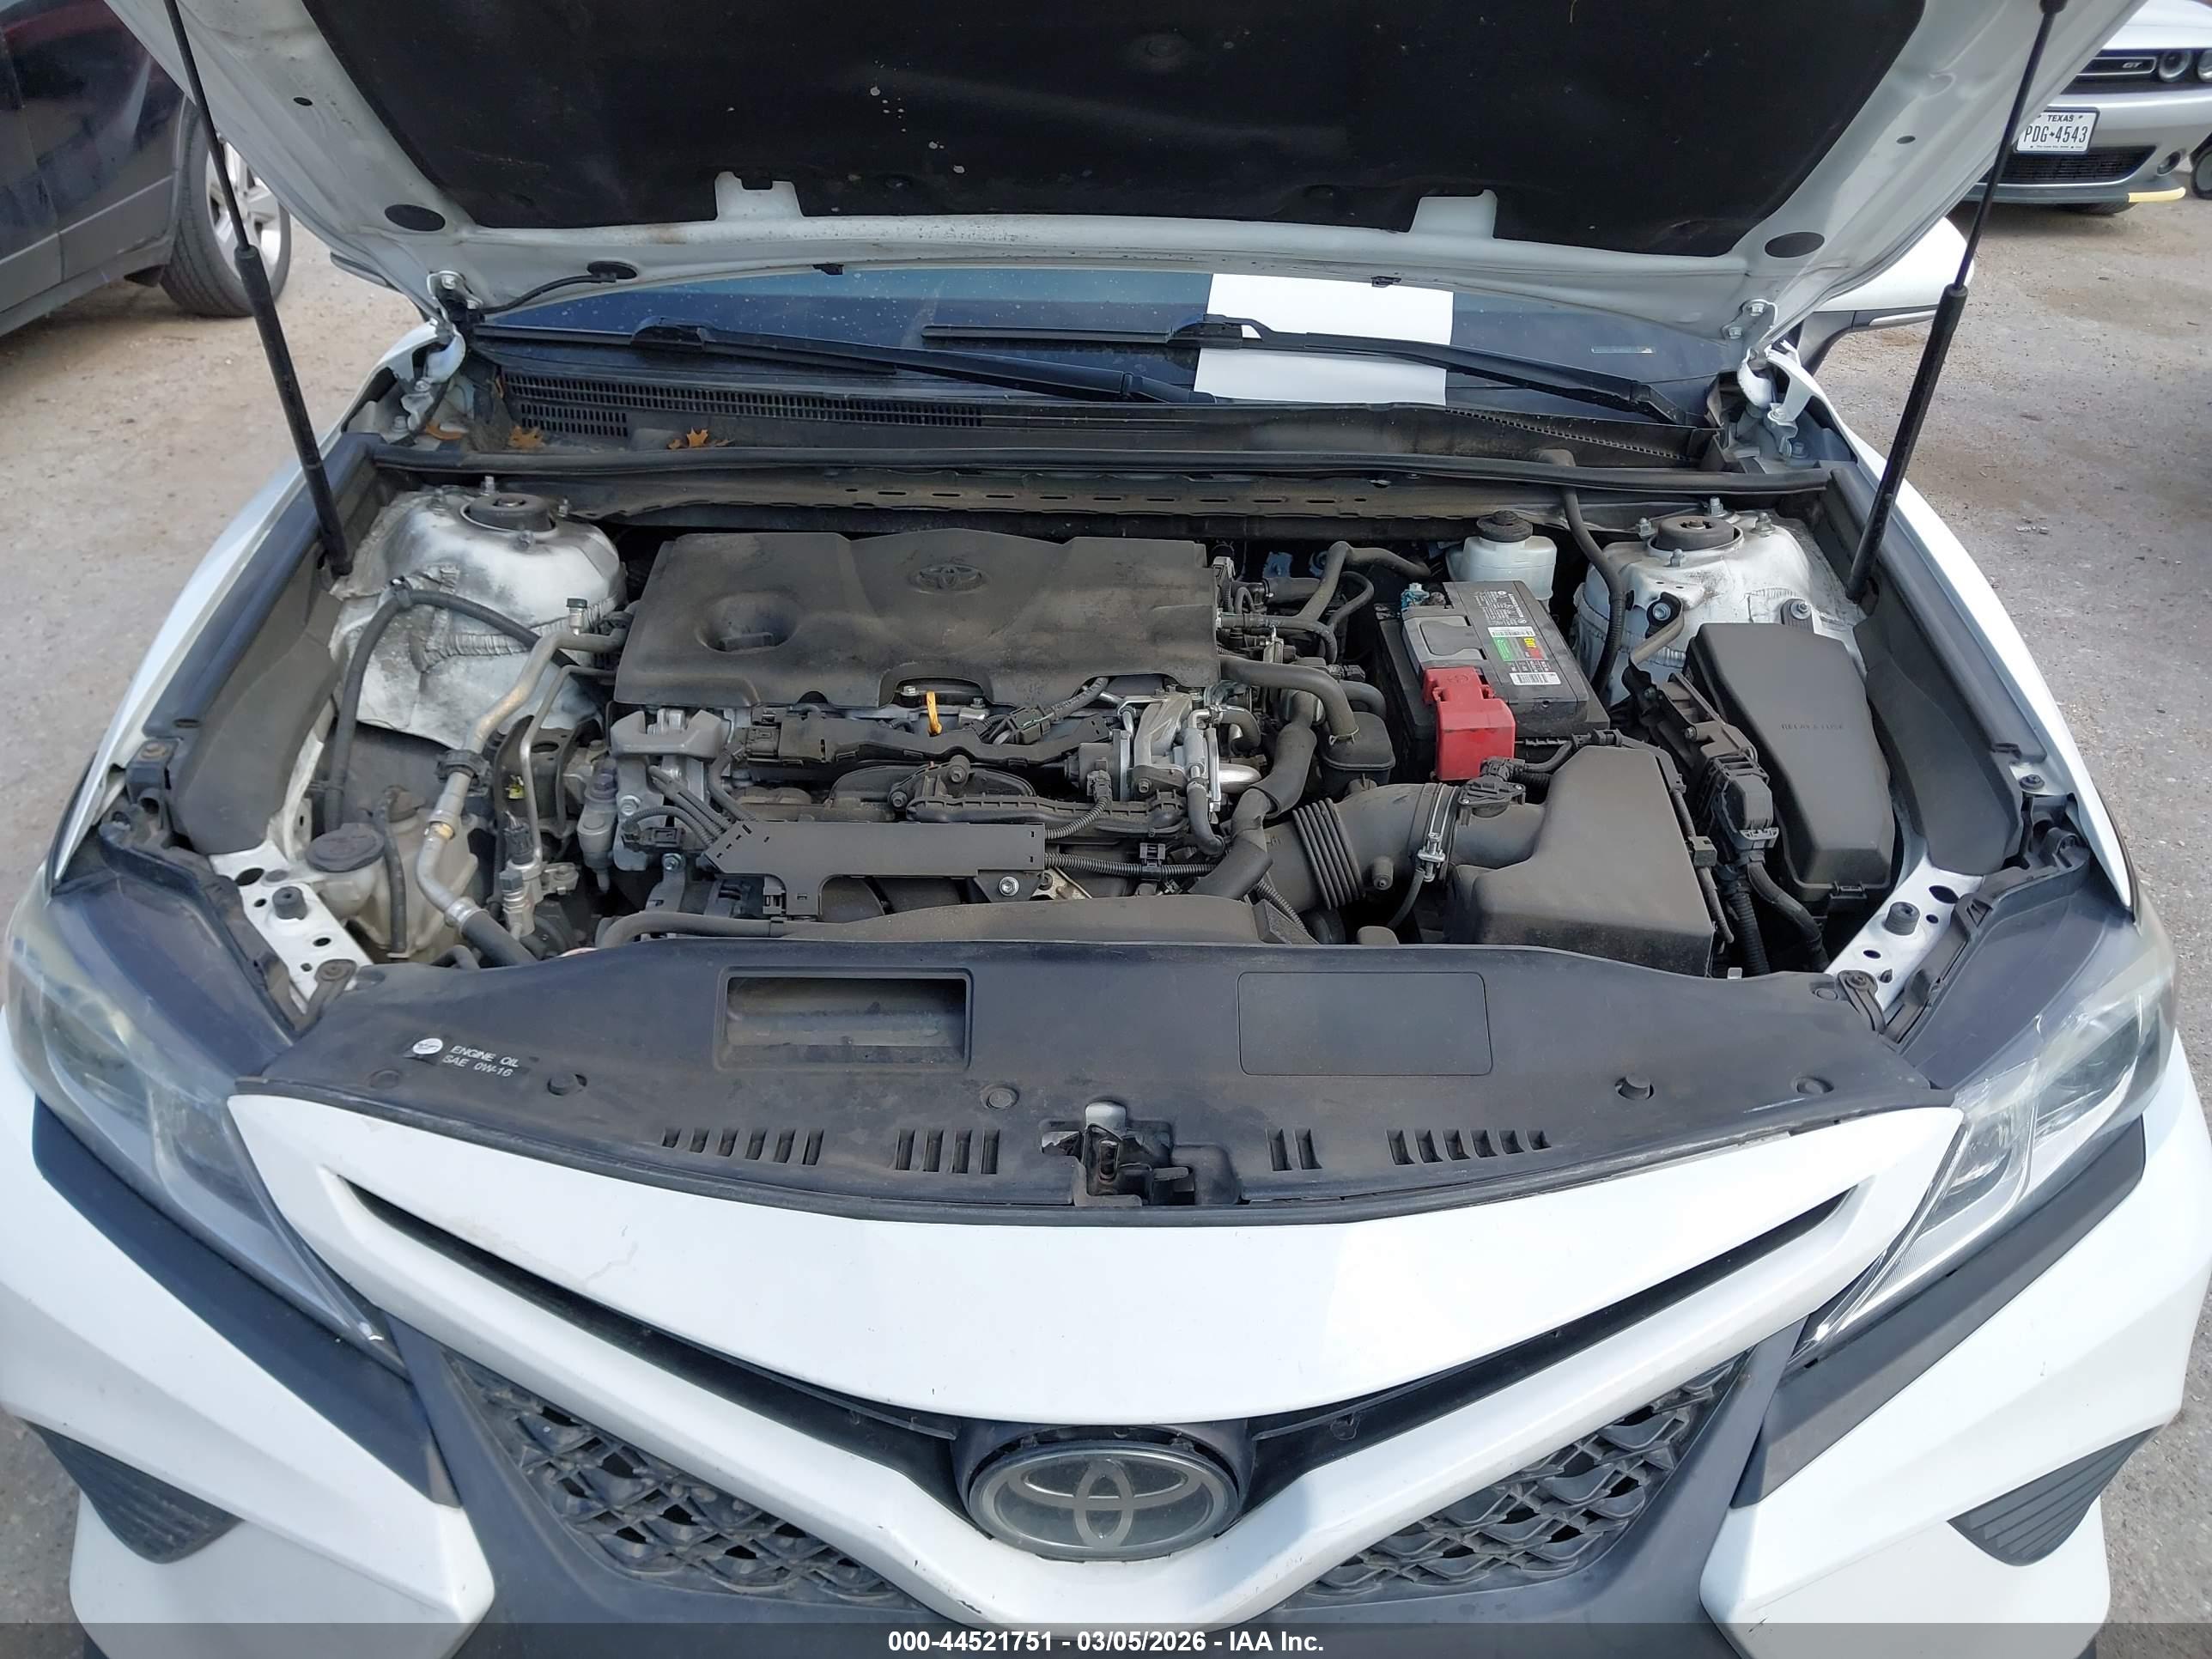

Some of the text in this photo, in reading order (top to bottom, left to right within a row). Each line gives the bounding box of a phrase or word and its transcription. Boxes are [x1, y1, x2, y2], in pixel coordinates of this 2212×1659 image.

[442, 1054, 514, 1077] SAE 0W-16
[450, 1045, 520, 1067] ENGINE OIL
